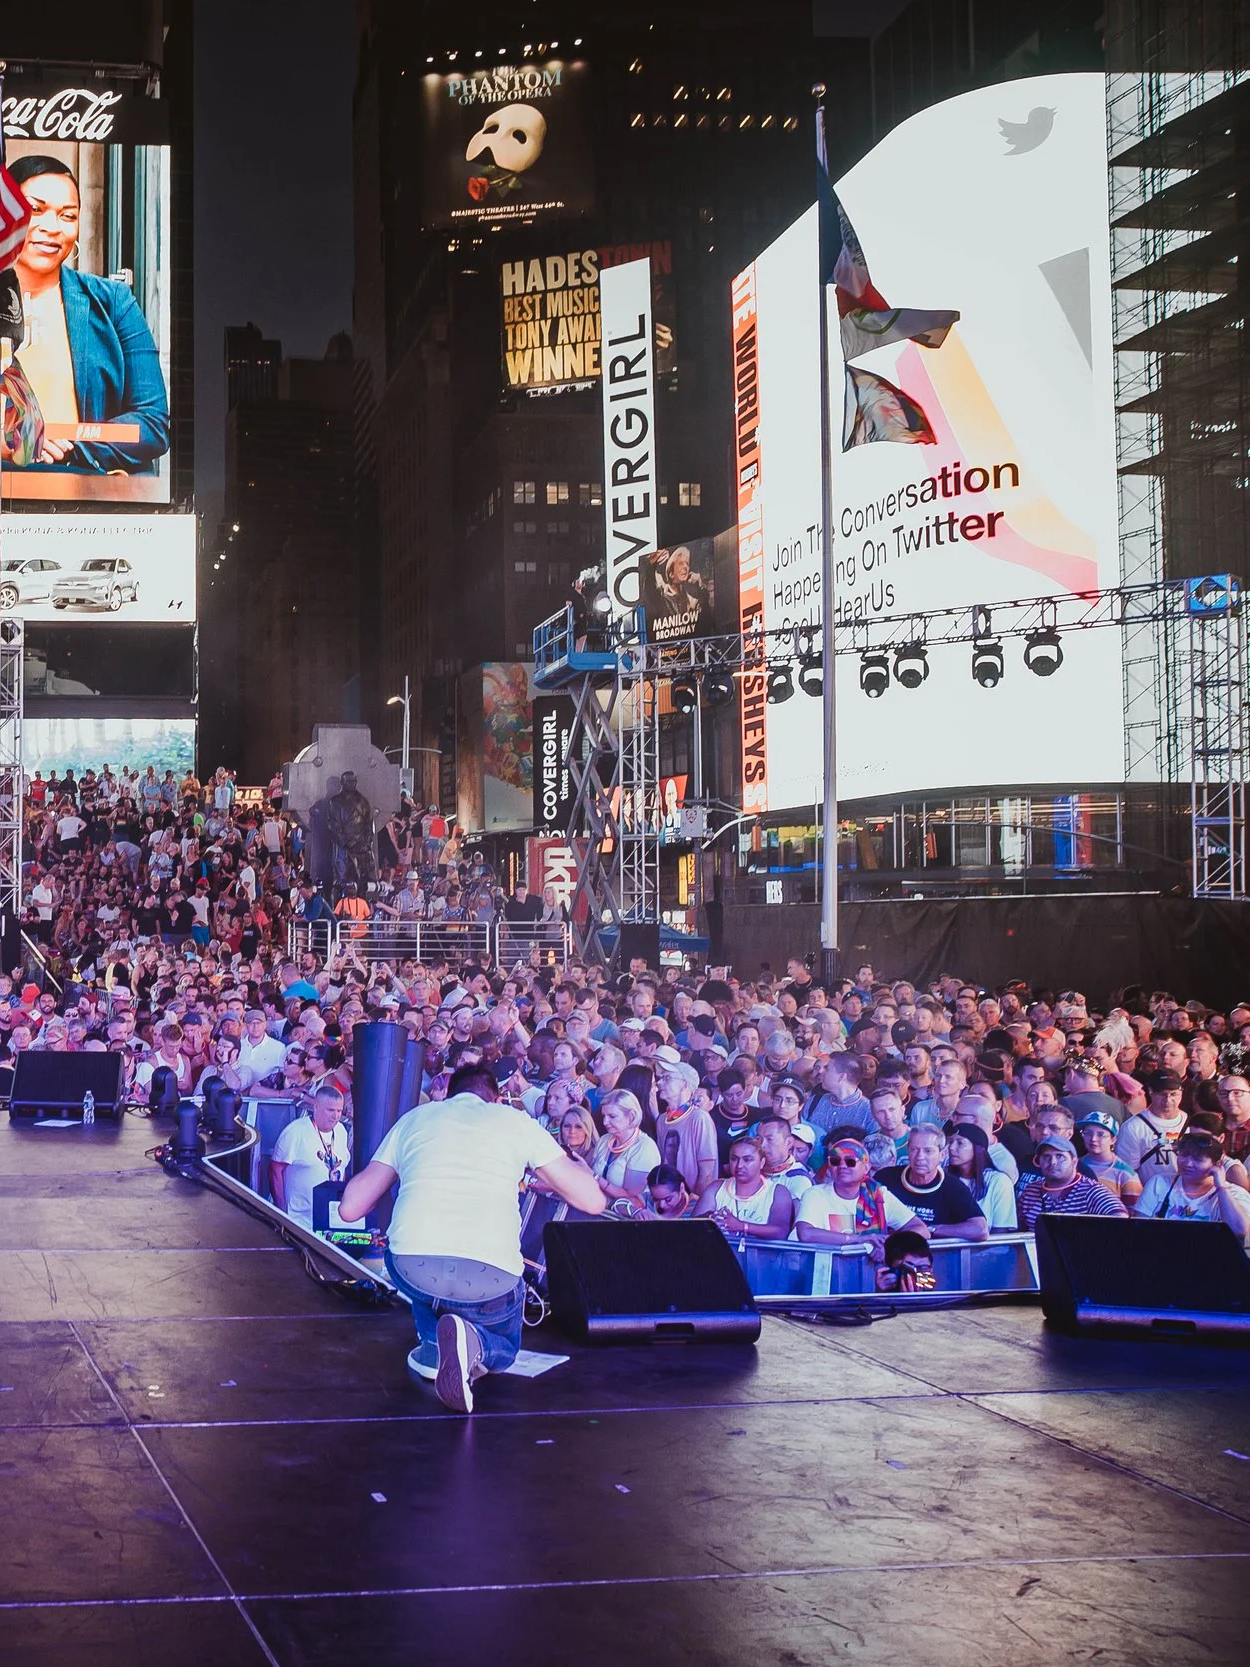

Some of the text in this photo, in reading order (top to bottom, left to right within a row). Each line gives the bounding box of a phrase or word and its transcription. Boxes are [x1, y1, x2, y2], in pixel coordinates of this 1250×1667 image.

[448, 69, 562, 97] PHANTOM
[459, 86, 552, 105] OF THE OPERA
[504, 287, 600, 323] BEST MUSIC
[505, 319, 552, 350] TONY
[505, 341, 603, 385] WINNE
[773, 537, 802, 572] Join
[841, 461, 1020, 538] Conversation
[774, 511, 1004, 610] Happeng On Twitter
[653, 610, 700, 631] MANILOW
[655, 623, 697, 641] BROADWAY
[542, 709, 557, 820] COVERGIRL
[560, 769, 569, 801] times
